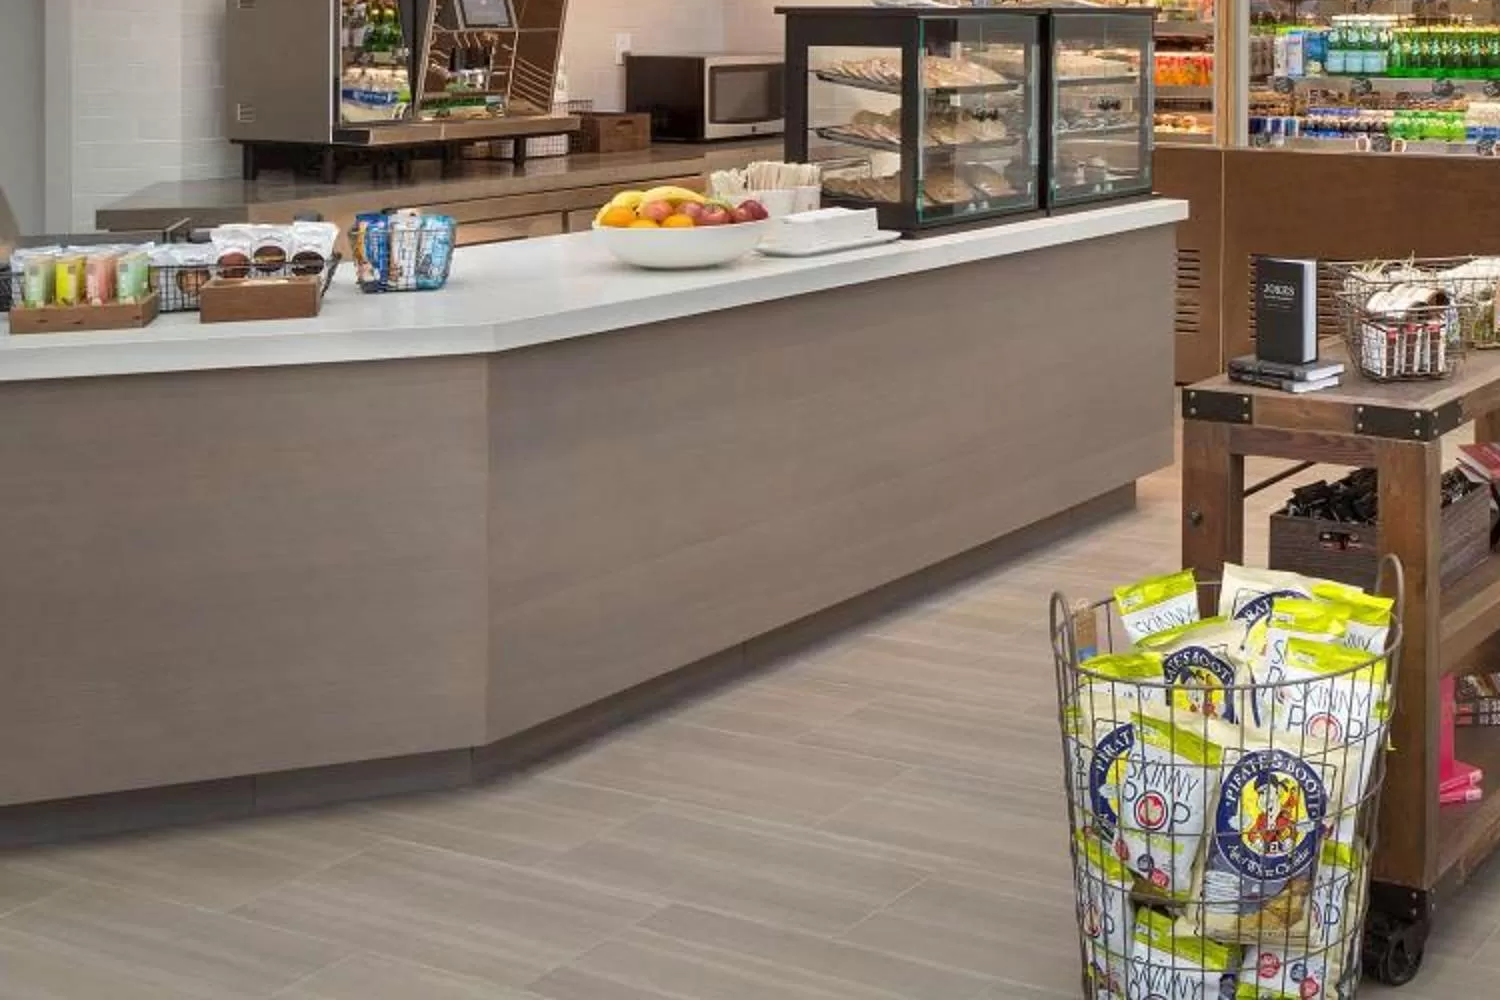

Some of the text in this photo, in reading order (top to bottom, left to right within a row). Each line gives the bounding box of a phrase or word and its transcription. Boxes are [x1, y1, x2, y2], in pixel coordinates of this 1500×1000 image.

[1134, 604, 1194, 634] SKINNY
[1287, 703, 1364, 745] POP
[1128, 754, 1199, 800] SKINNY
